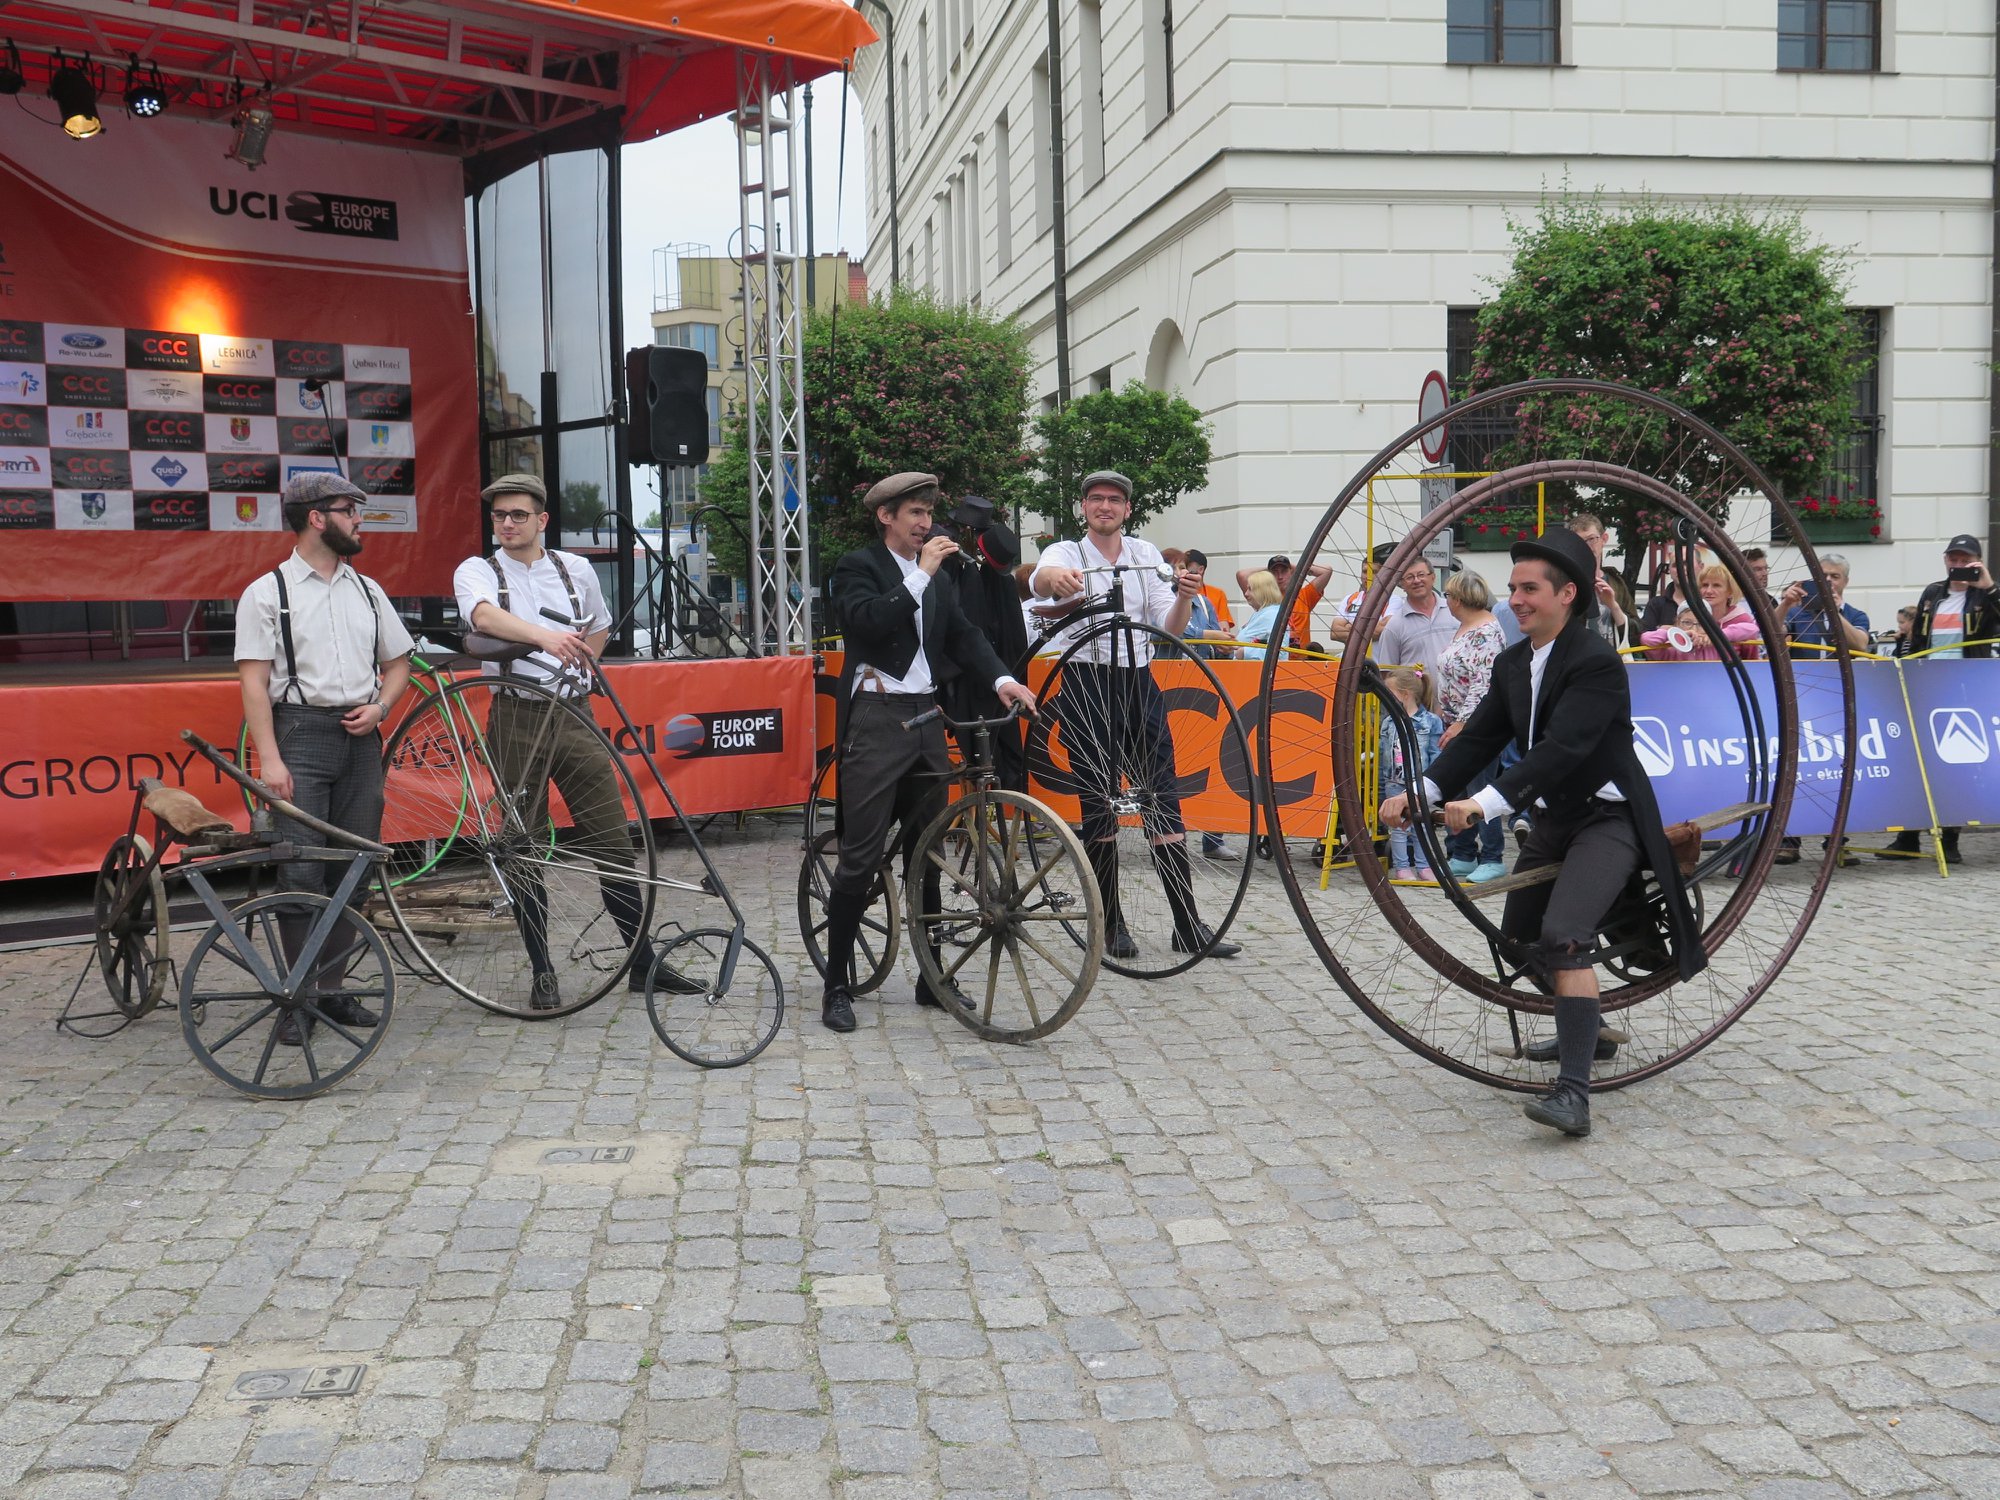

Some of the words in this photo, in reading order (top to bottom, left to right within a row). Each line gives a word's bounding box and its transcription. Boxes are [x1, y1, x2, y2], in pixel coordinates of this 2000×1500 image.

[209, 186, 278, 220] UCI
[331, 202, 390, 220] EUROPE
[332, 215, 374, 232] TOUR
[70, 333, 97, 347] Ford
[143, 338, 189, 357] CCC
[58, 349, 87, 357] Re-Wo
[89, 350, 112, 358] Lubin
[218, 347, 257, 359] LEGNICA
[287, 348, 331, 365] CCC
[352, 359, 378, 369] Qubus
[379, 360, 401, 369] Hotel
[63, 375, 110, 393] CCC
[217, 383, 261, 399] CCC
[358, 392, 399, 408] CCC
[145, 419, 192, 436] CCC
[291, 425, 332, 441] CCC
[66, 457, 113, 473] CCC
[222, 461, 268, 477] CCC
[363, 465, 402, 480] CCC
[0, 498, 36, 515] CC
[150, 499, 196, 515] CCC
[712, 716, 775, 734] EUROPE
[712, 734, 756, 749] TOUR
[0, 749, 196, 799] GRODY
[1867, 765, 1891, 778] LED
